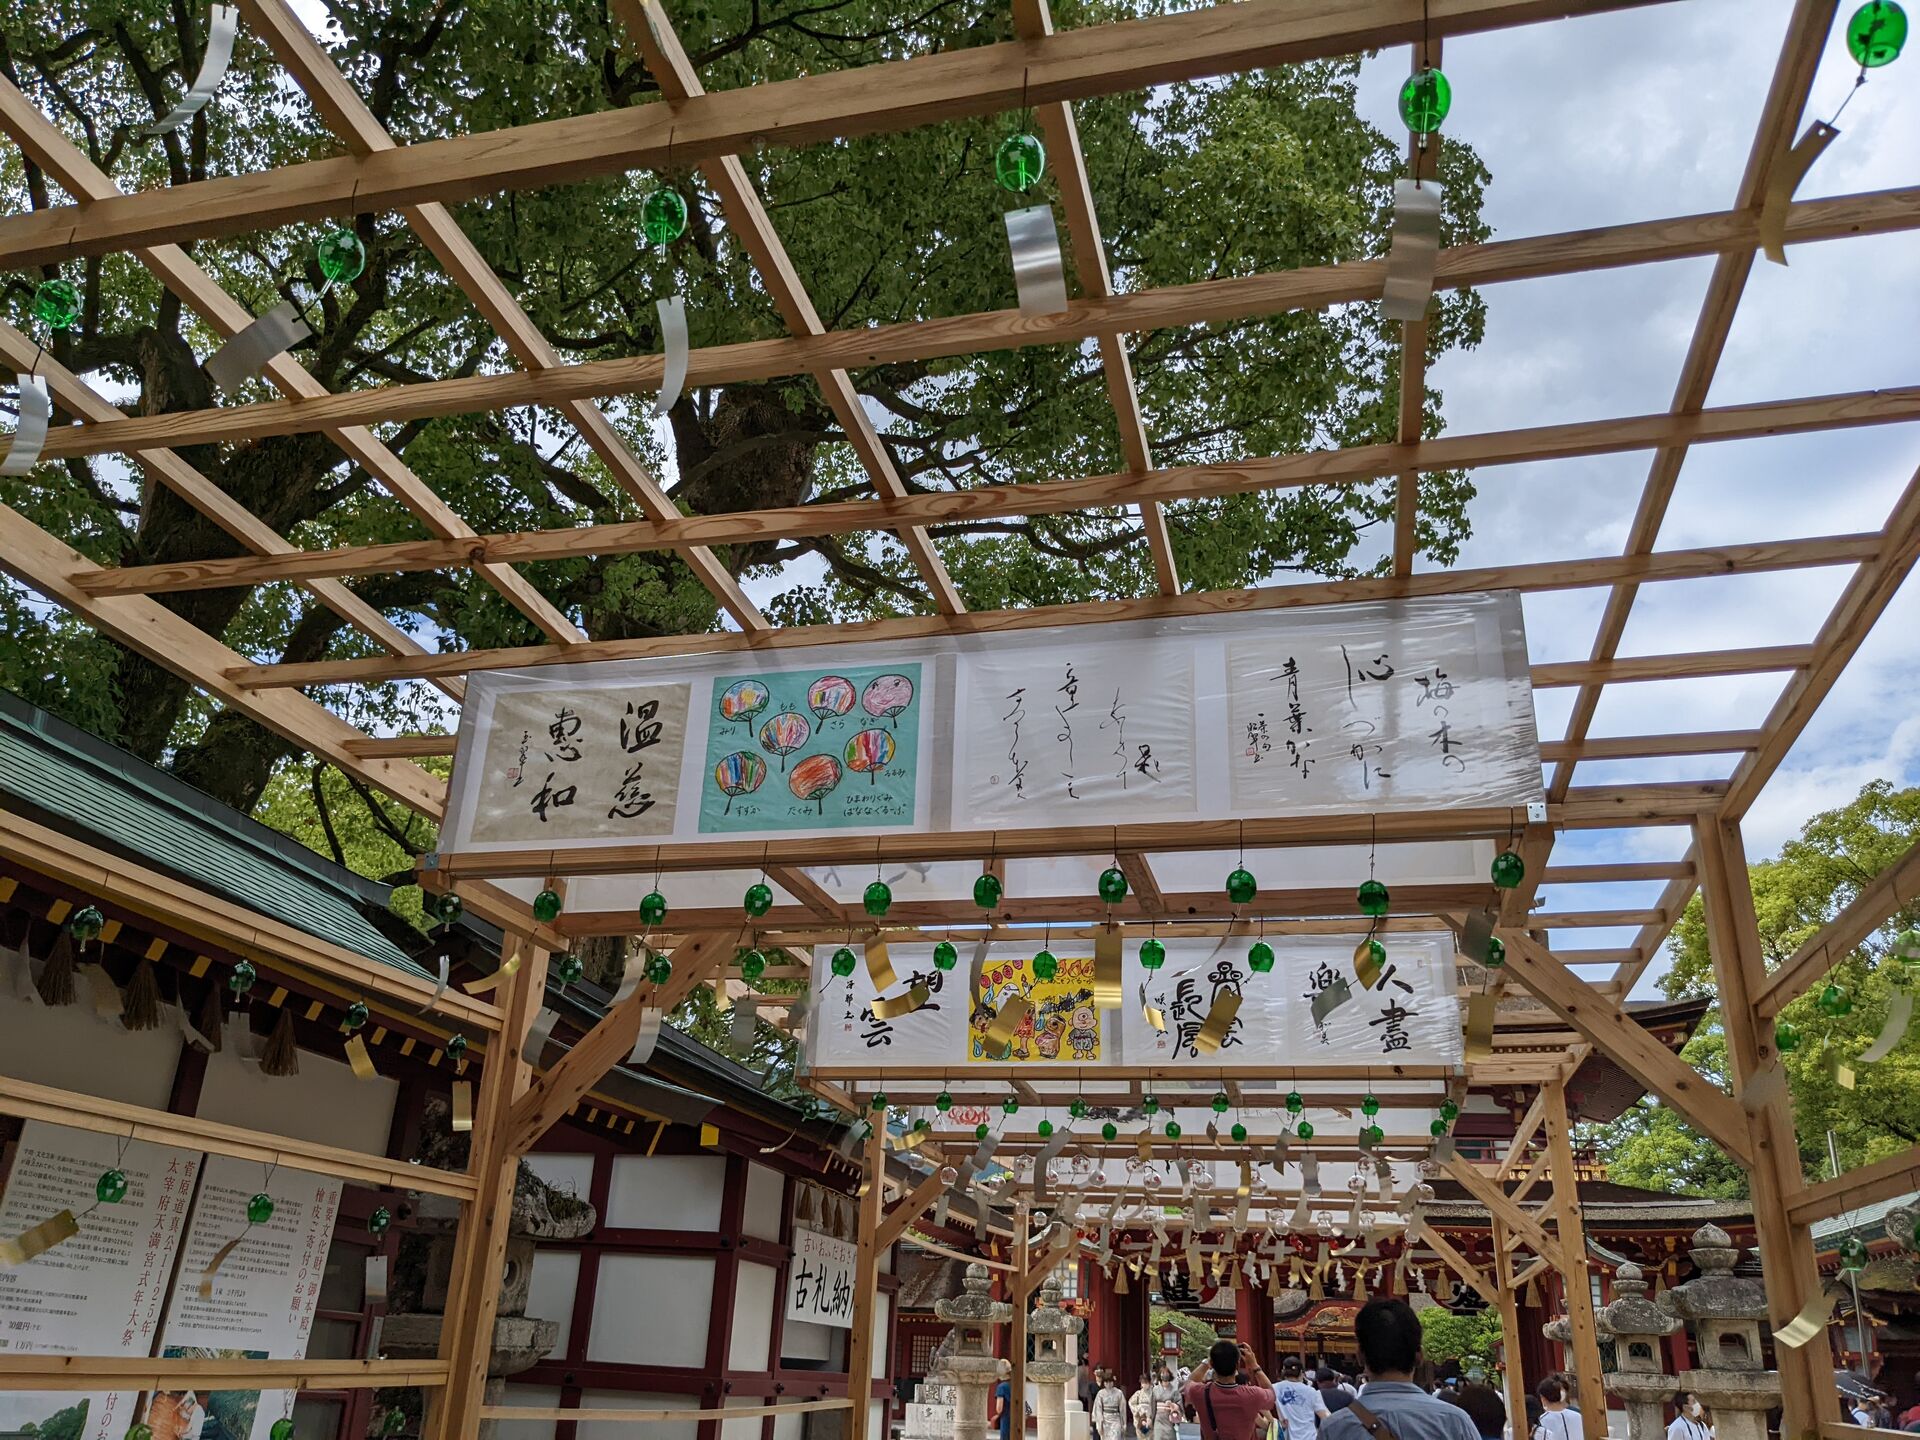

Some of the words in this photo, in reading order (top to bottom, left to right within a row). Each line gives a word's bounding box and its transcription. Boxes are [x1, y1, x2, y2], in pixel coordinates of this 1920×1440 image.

[121, 1157, 180, 1348] 太宰府天満宮式年大祭
[140, 1160, 196, 1338] 菅原道真公1125年
[296, 1190, 339, 1341] 重要文化財「御本殿」
